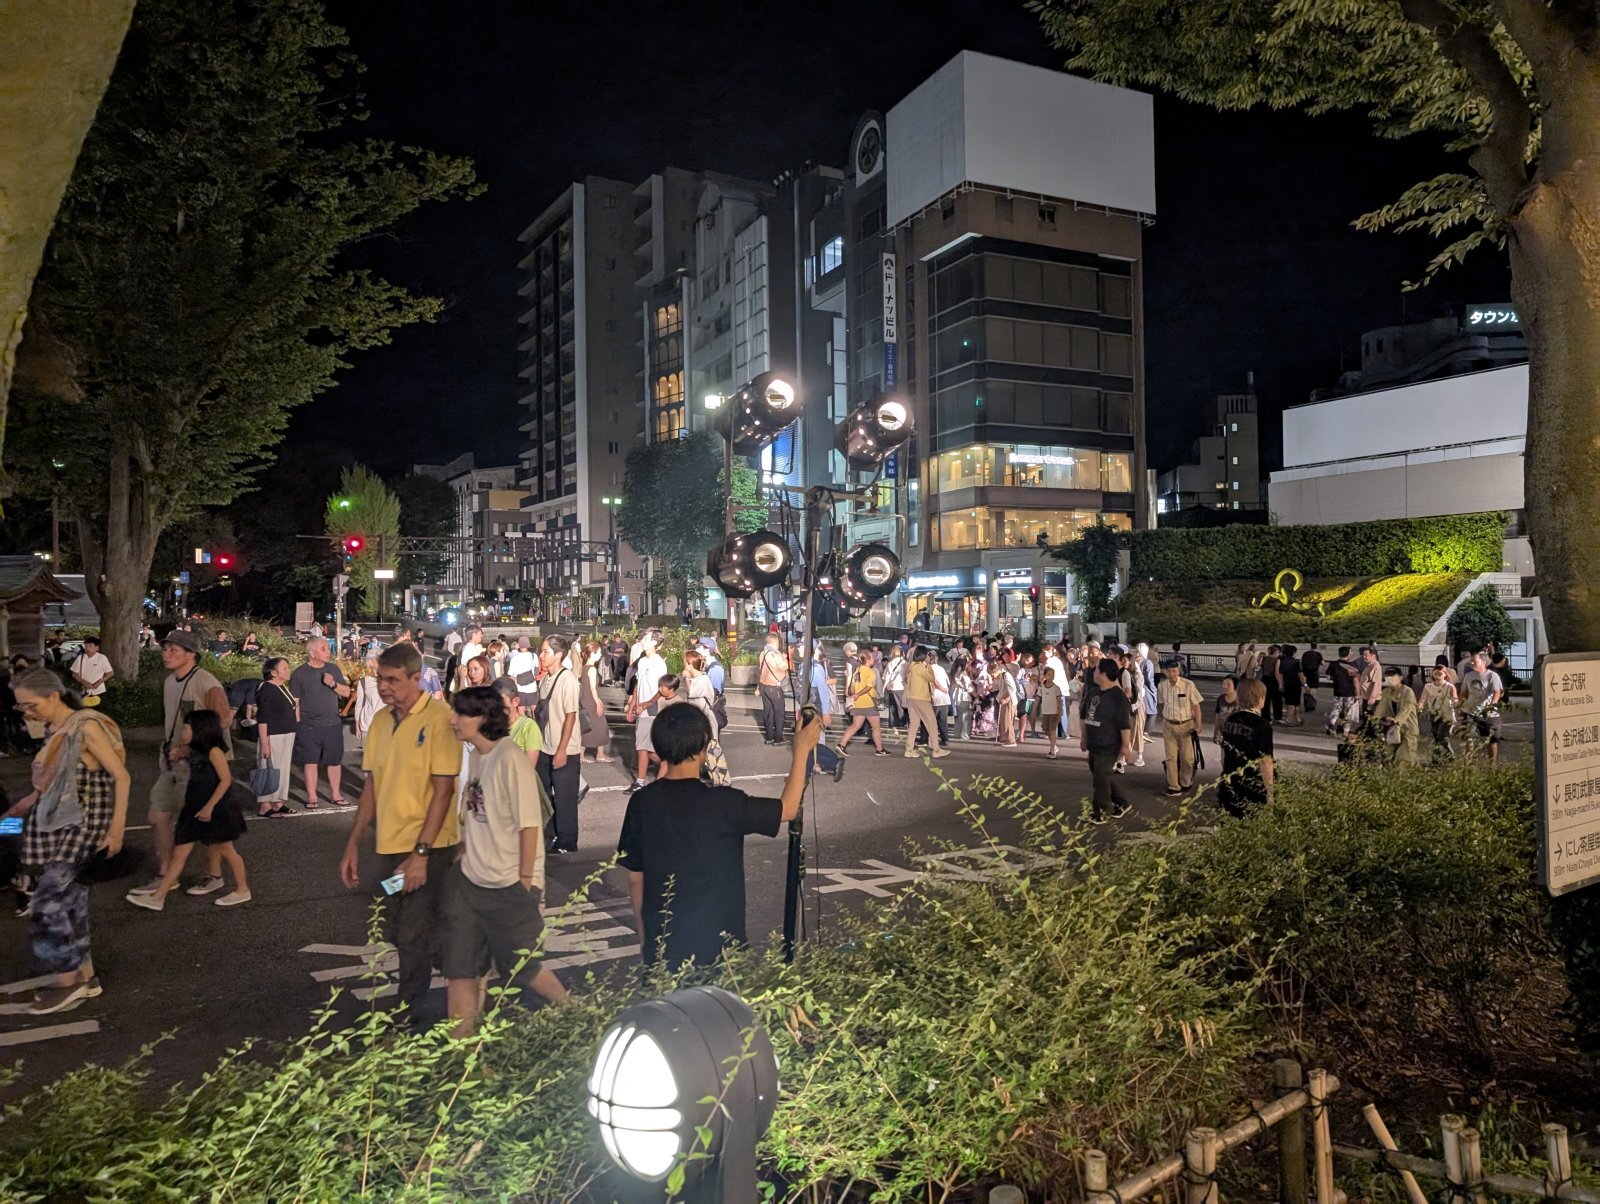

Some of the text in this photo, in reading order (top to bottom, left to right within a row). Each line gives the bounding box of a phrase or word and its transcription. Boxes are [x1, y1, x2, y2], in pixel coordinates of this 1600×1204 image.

[885, 272, 895, 338] ドーナツビル
[1562, 673, 1586, 691] 金沢駅
[1562, 696, 1585, 706] Kanazawa
[1563, 726, 1599, 747] 金沢城公園
